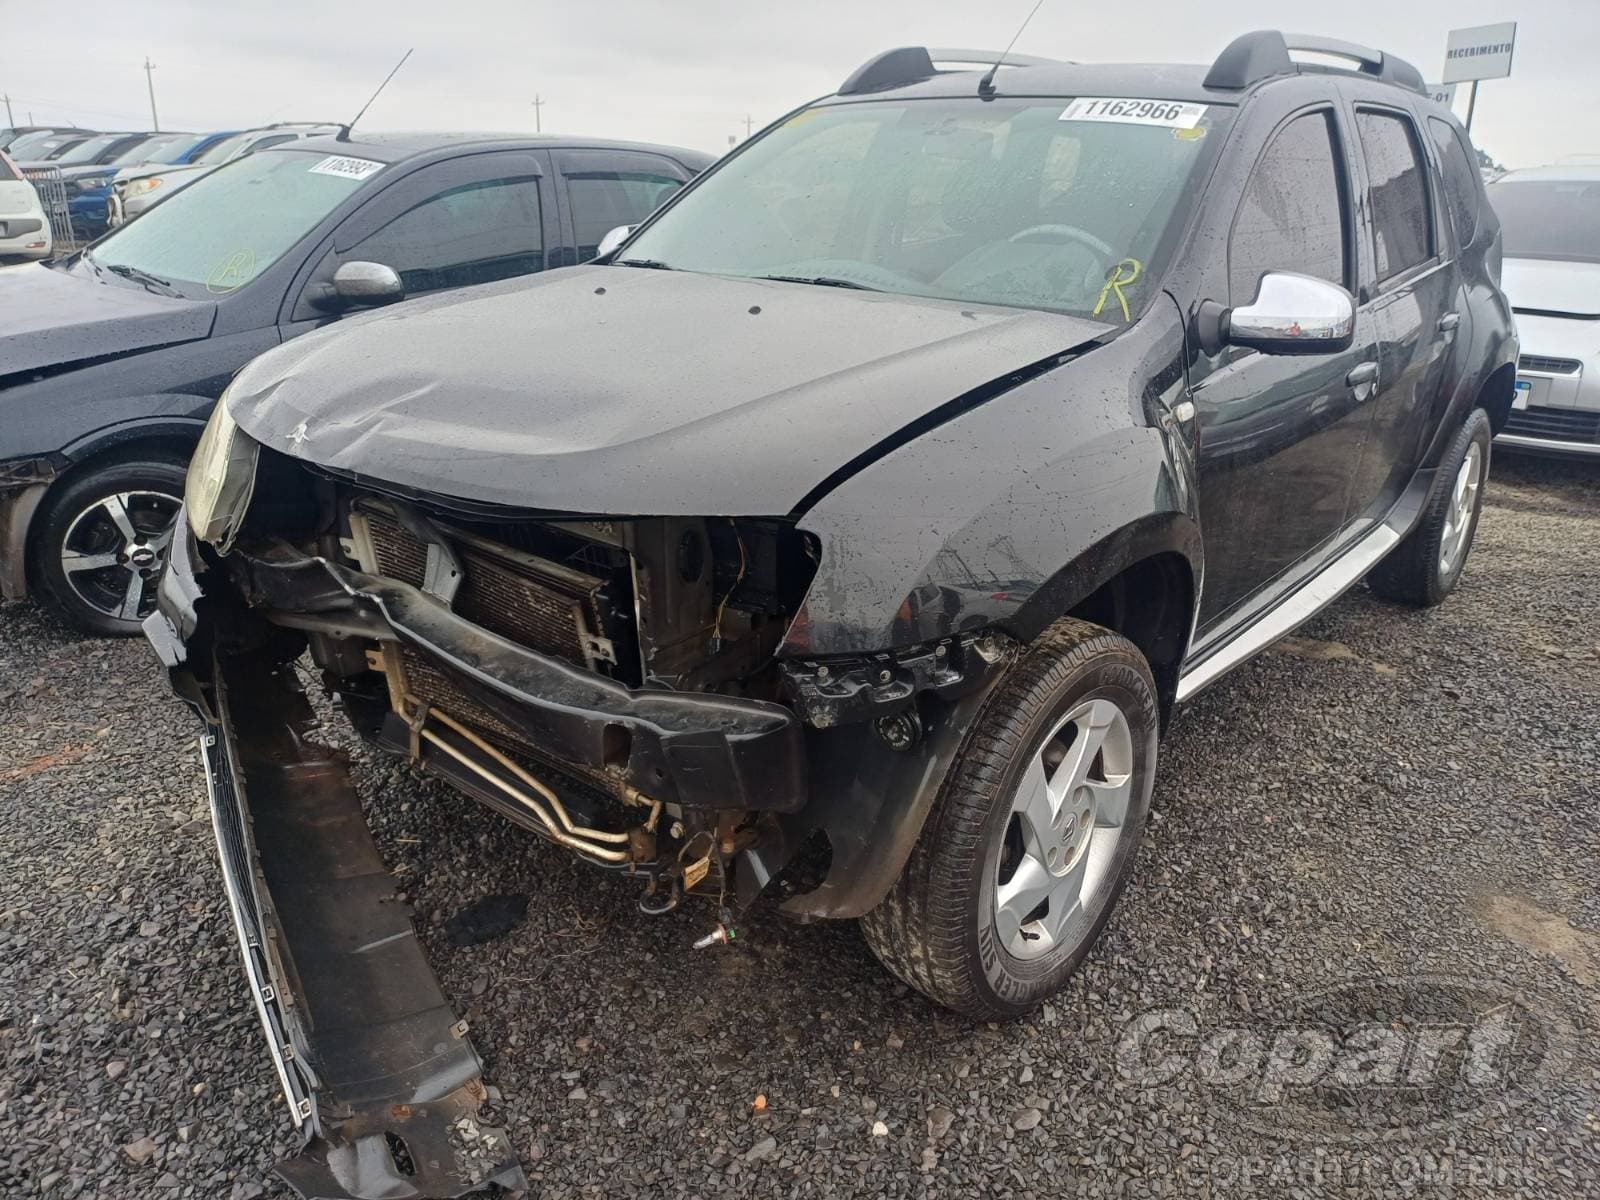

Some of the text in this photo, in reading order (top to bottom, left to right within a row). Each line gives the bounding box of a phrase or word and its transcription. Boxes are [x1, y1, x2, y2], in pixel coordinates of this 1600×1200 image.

[1446, 43, 1512, 60] RECEBIMENTO
[1084, 101, 1183, 121] 1162966
[1092, 258, 1141, 322] R
[979, 923, 997, 971] SUV
